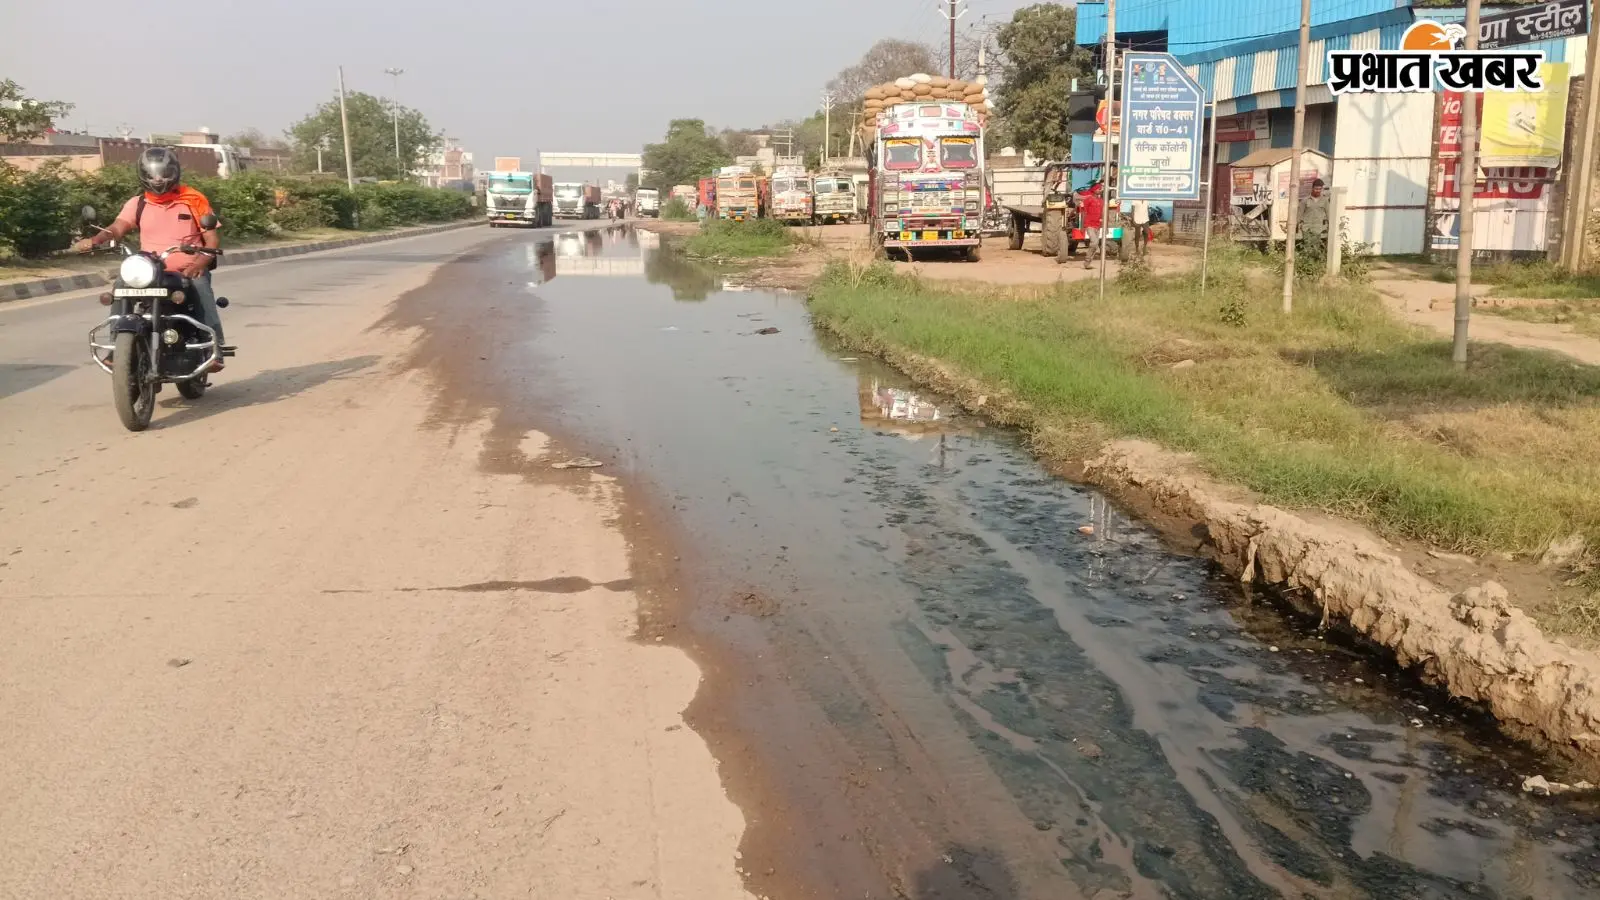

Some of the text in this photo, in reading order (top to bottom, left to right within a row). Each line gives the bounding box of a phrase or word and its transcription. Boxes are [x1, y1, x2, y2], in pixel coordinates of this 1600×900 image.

[1480, 3, 1583, 42] णा स्टील
[1132, 106, 1194, 120] नगर परिषद बक्सर
[1443, 97, 1462, 115] io
[1136, 122, 1153, 134] वार्ड
[1135, 141, 1188, 152] सैनिक कॉलोनी
